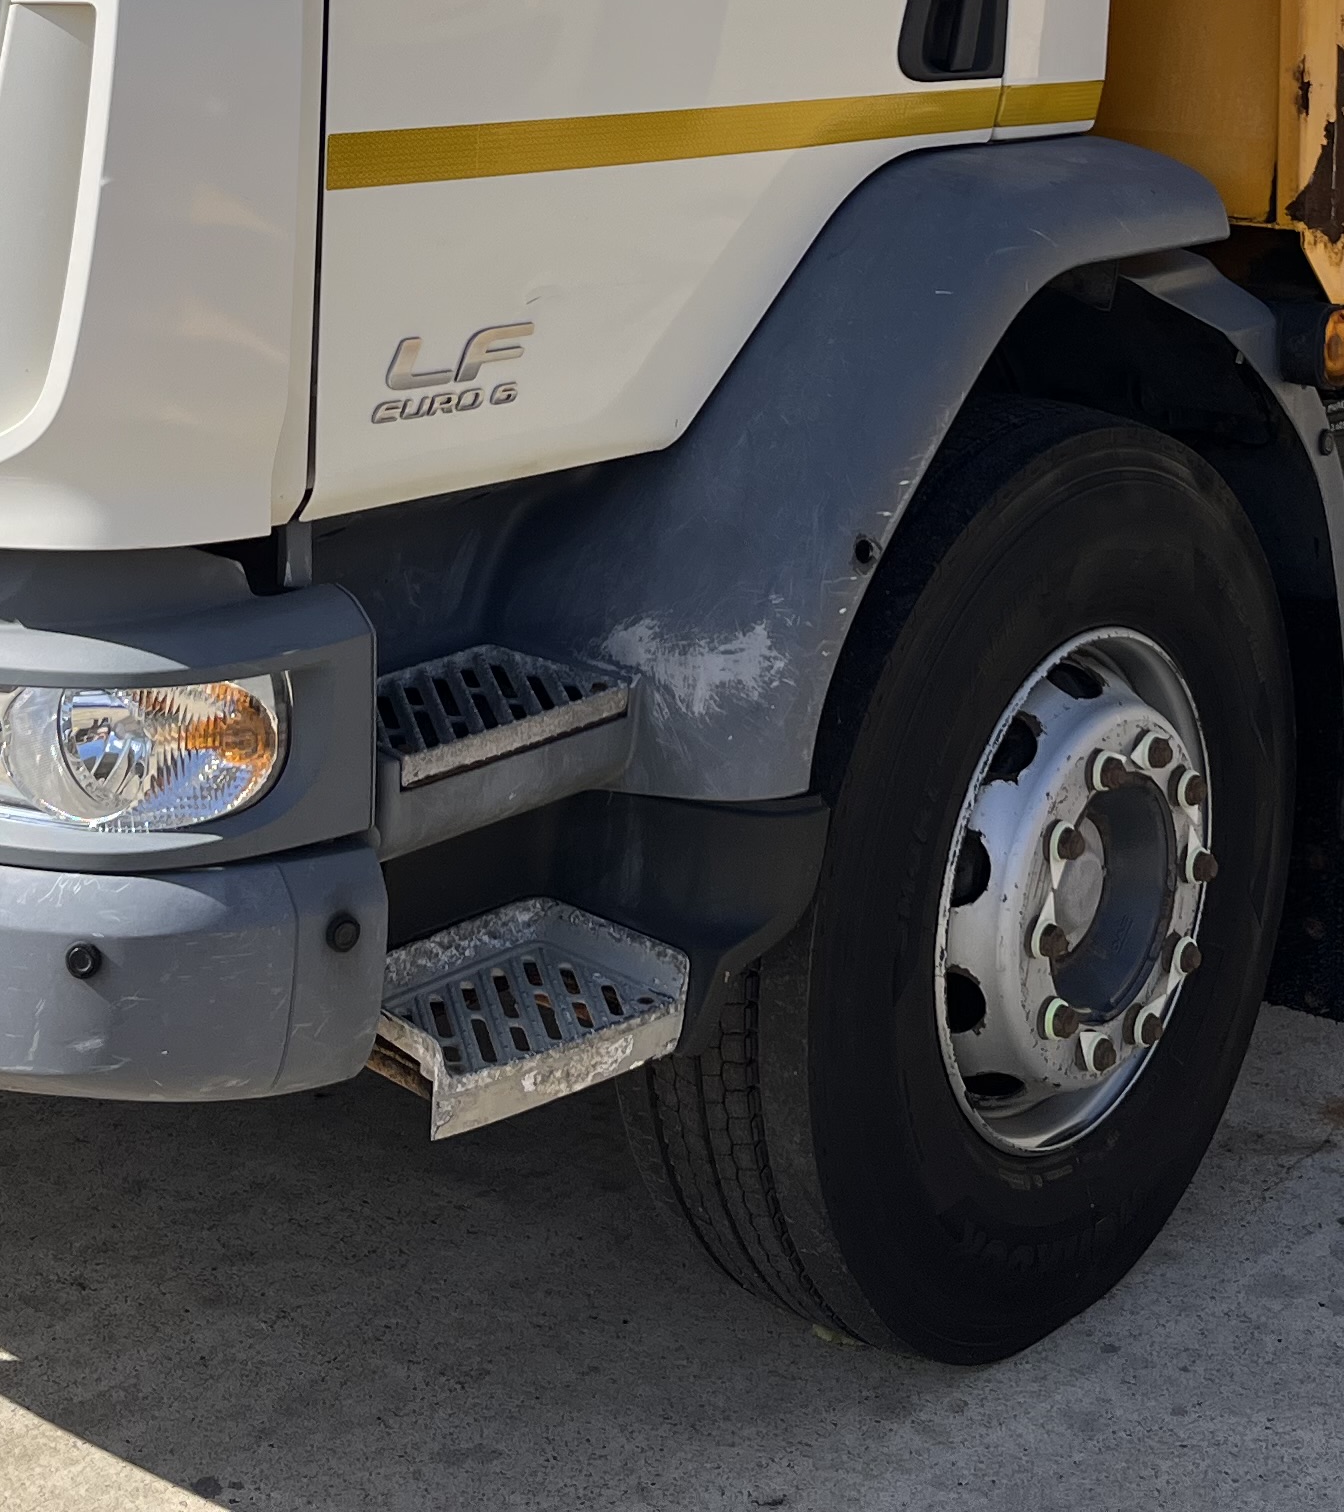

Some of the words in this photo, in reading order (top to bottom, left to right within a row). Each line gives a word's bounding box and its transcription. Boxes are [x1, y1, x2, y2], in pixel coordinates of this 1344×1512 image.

[385, 321, 535, 390] LF
[371, 388, 484, 424] EURO
[489, 381, 518, 405] 6
